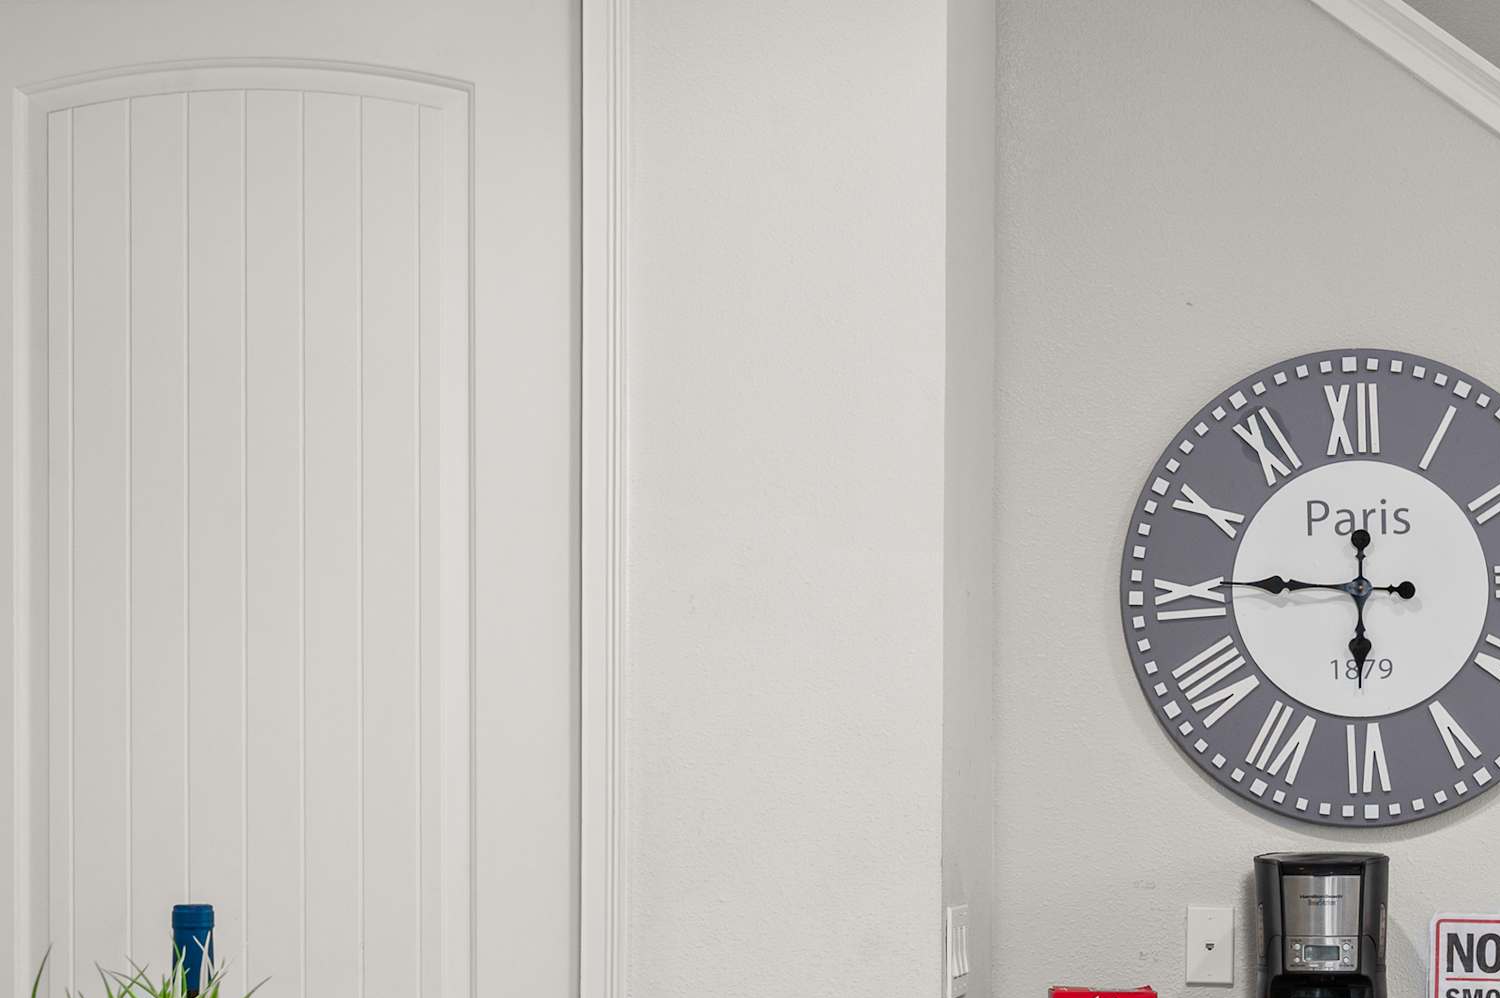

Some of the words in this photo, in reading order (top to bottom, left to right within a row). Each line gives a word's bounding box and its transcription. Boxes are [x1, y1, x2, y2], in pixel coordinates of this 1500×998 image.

[1324, 383, 1380, 455] XII
[1233, 407, 1302, 486] XI
[1172, 484, 1245, 539] X
[1306, 499, 1411, 536] Paris
[1154, 576, 1227, 620] IX
[1330, 659, 1393, 680] 1879
